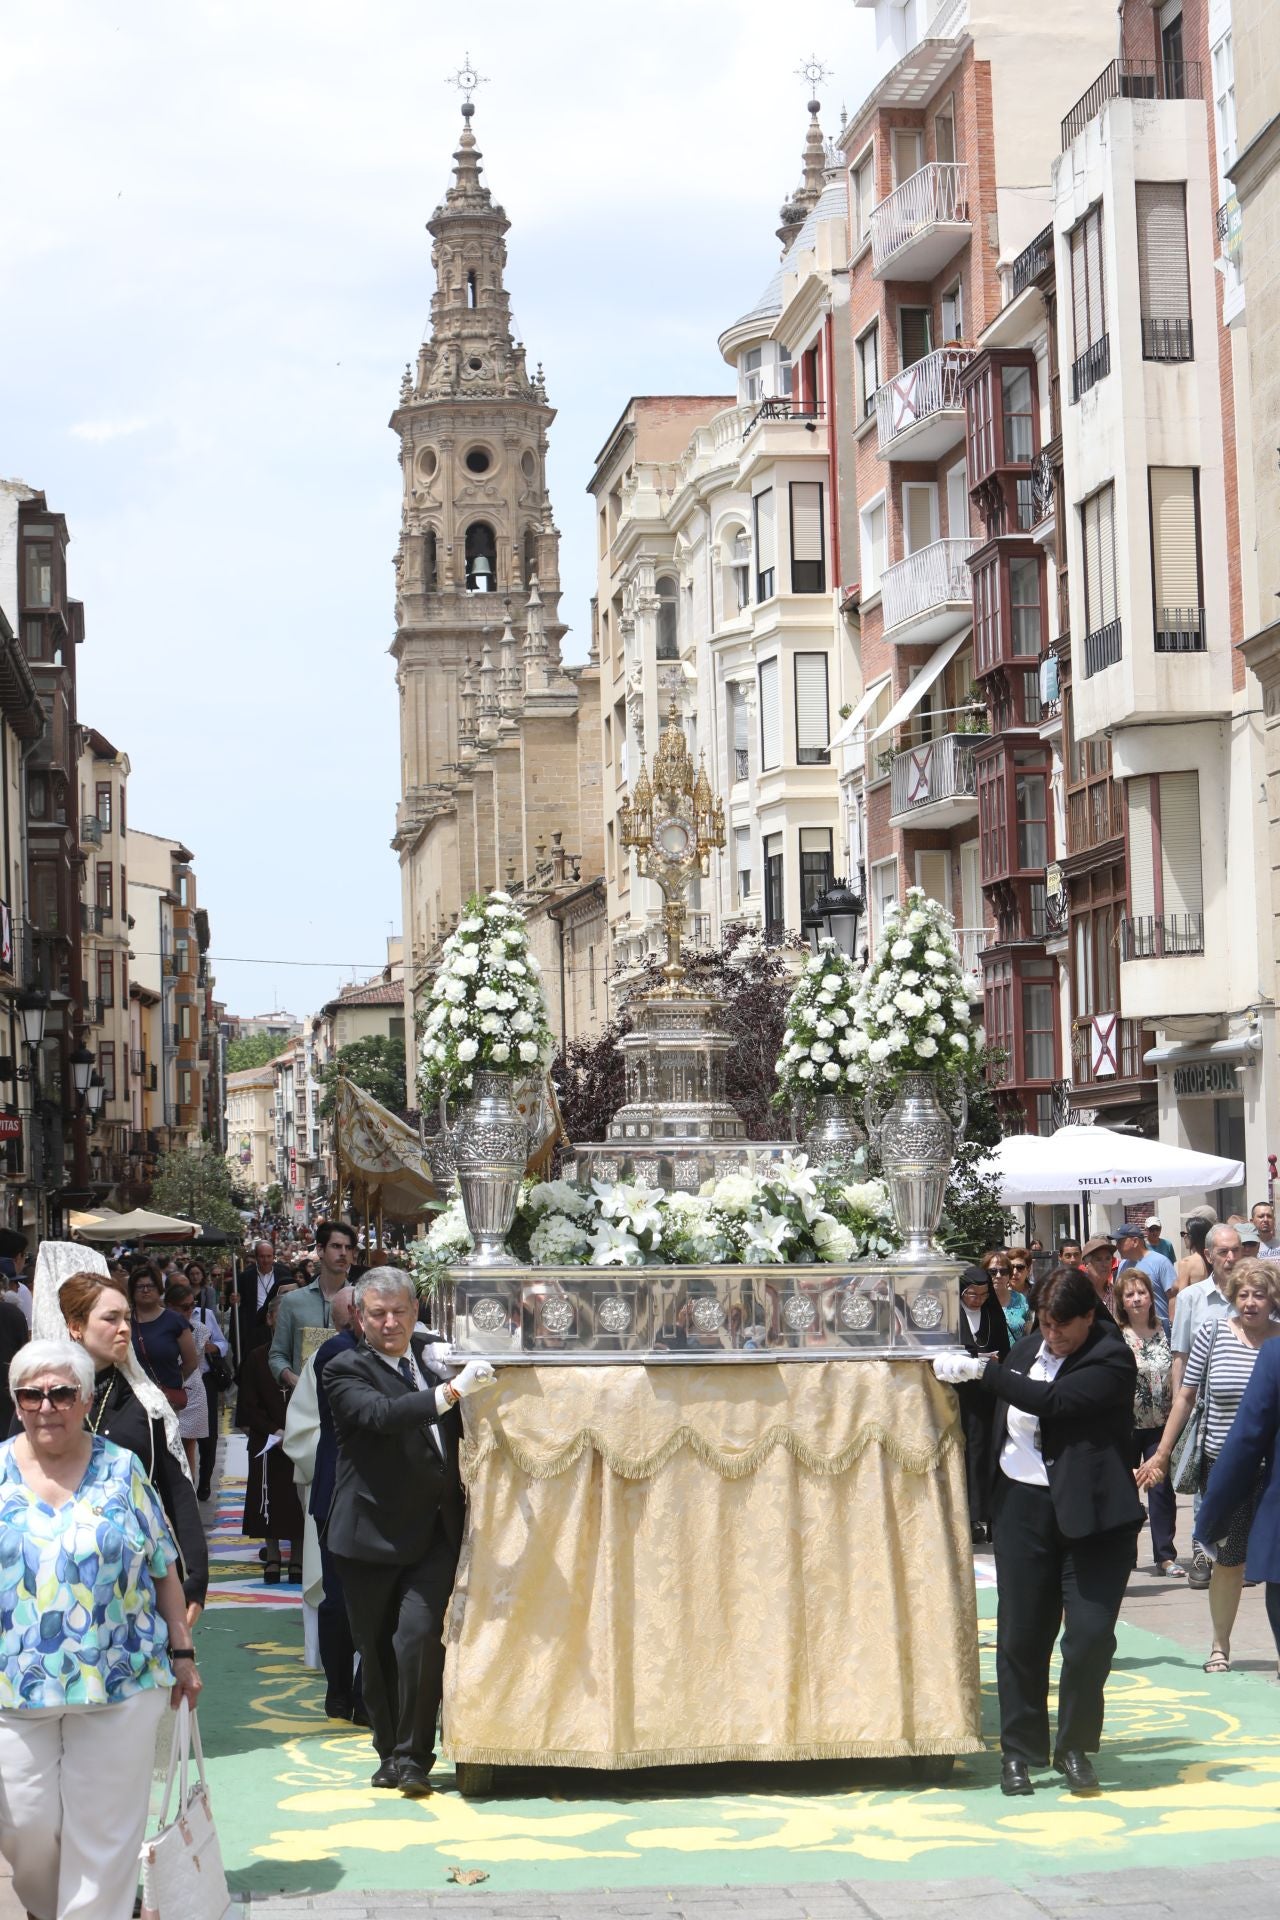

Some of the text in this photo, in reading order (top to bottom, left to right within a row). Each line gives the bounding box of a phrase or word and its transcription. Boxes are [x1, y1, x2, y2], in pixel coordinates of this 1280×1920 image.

[1174, 1063, 1235, 1093] ORTOPEDIA
[0, 1120, 19, 1131] ITAS
[1078, 1175, 1153, 1185] STELLA ARTOIS
